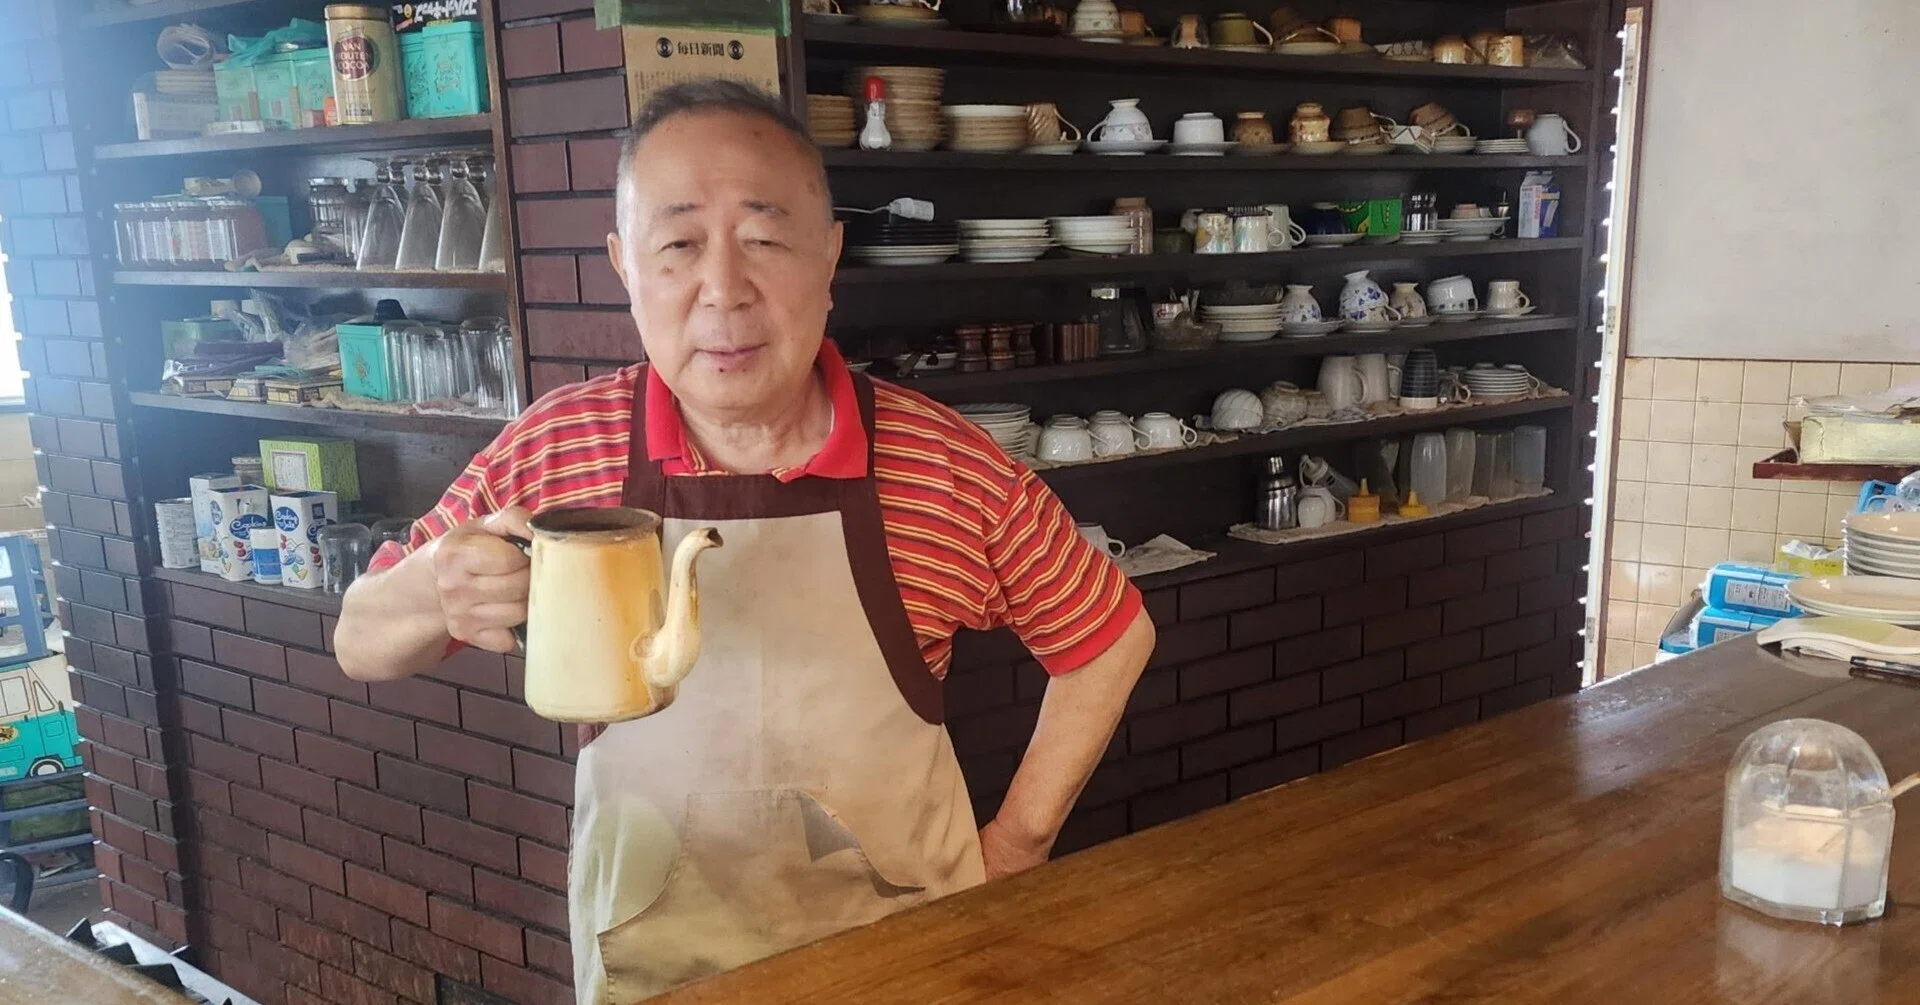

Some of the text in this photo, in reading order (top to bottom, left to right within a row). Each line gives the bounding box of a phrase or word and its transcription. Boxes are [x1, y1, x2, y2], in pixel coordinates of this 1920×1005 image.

[342, 42, 361, 51] VAN
[678, 41, 725, 57] 毎日新聞
[338, 60, 370, 70] COCOA
